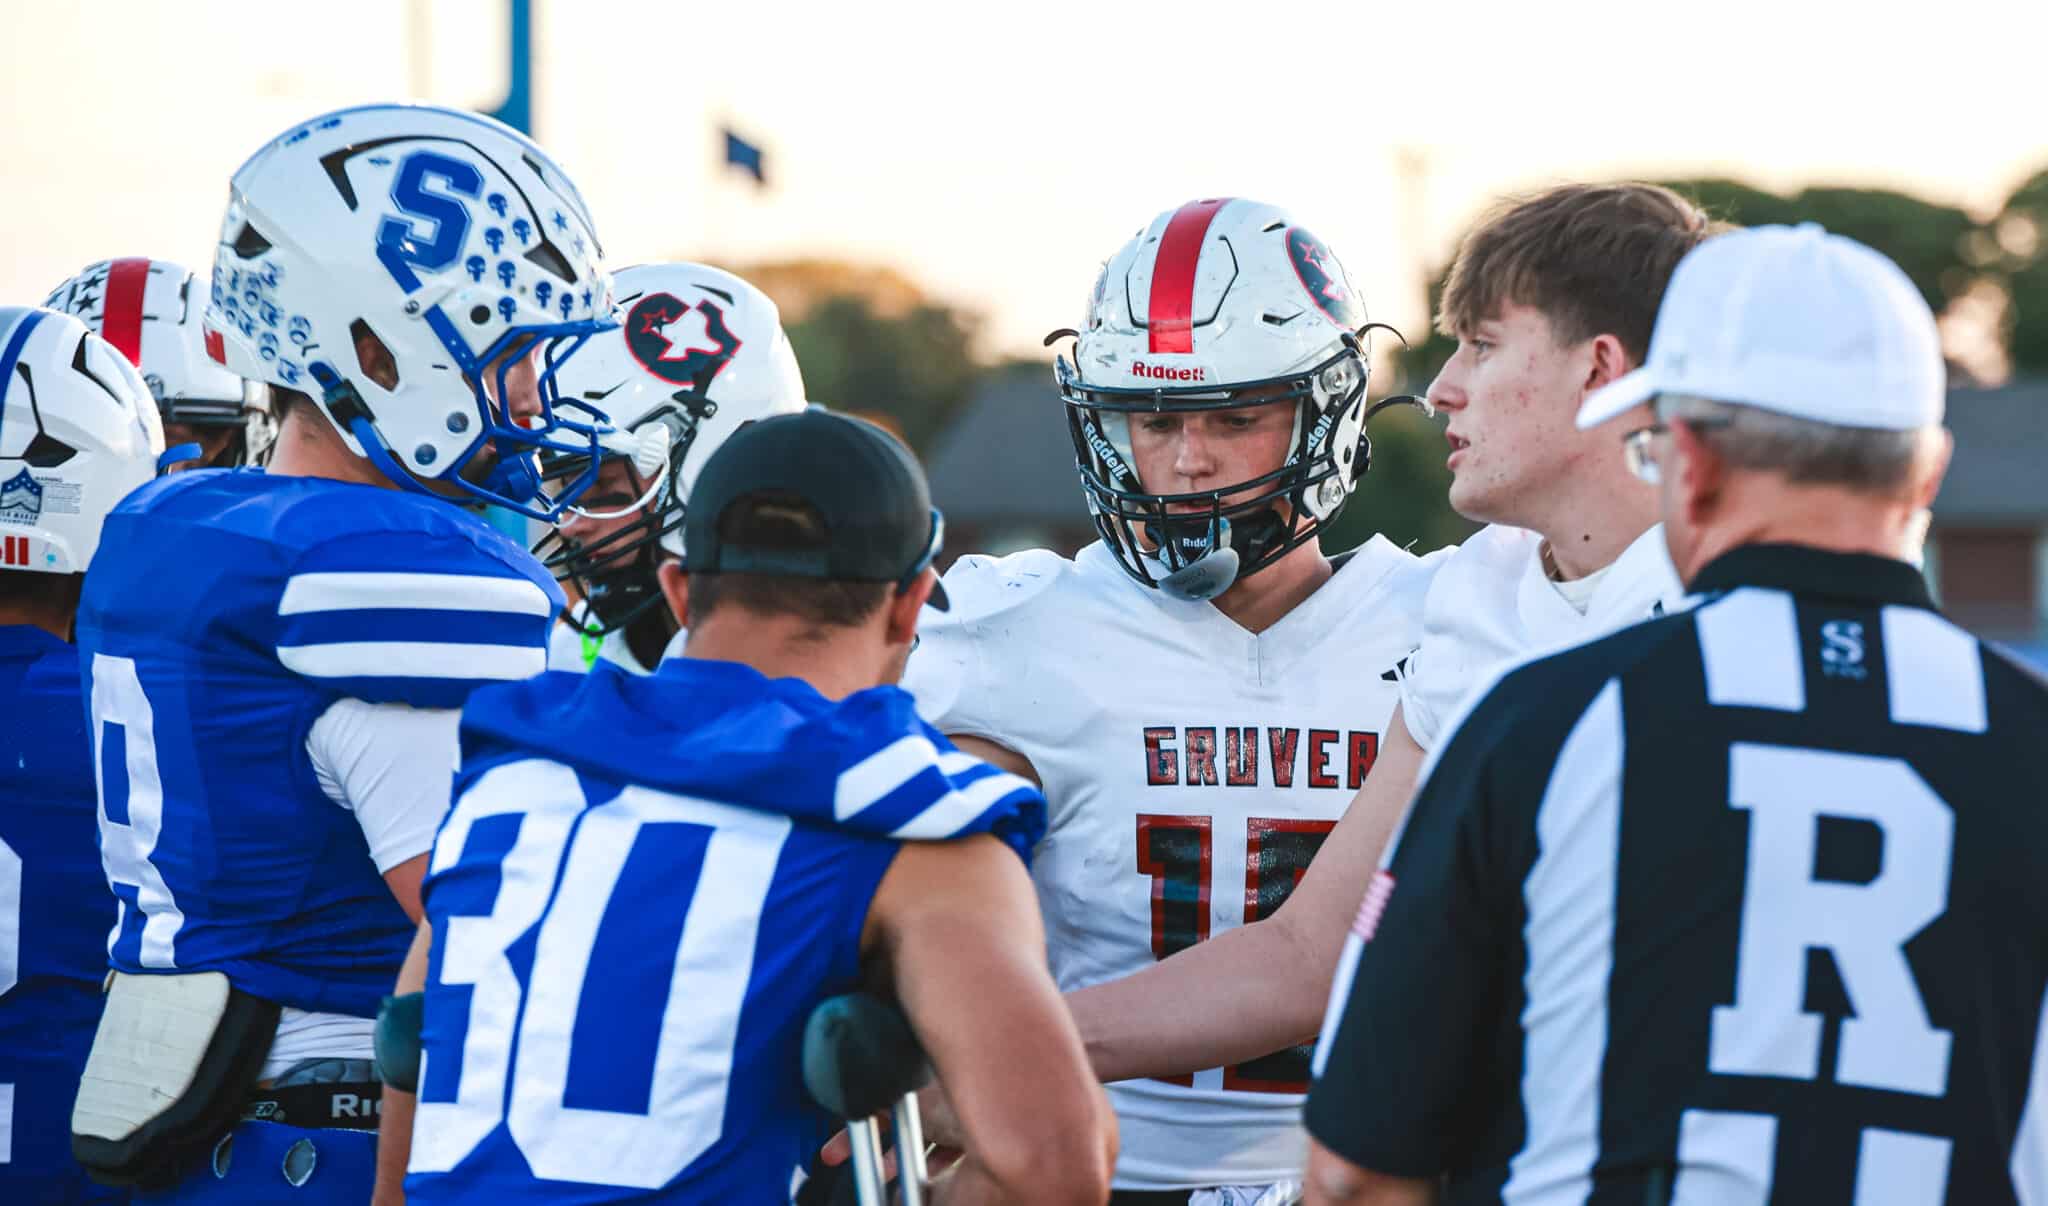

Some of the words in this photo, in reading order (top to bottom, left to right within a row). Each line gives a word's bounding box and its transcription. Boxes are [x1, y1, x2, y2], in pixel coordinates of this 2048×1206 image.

[1085, 422, 1128, 480] Riddell
[0, 535, 29, 566] ll
[1182, 537, 1208, 548] Ridd
[1143, 726, 1379, 790] GRUVER
[1709, 742, 1956, 1097] R
[408, 758, 793, 1189] 30
